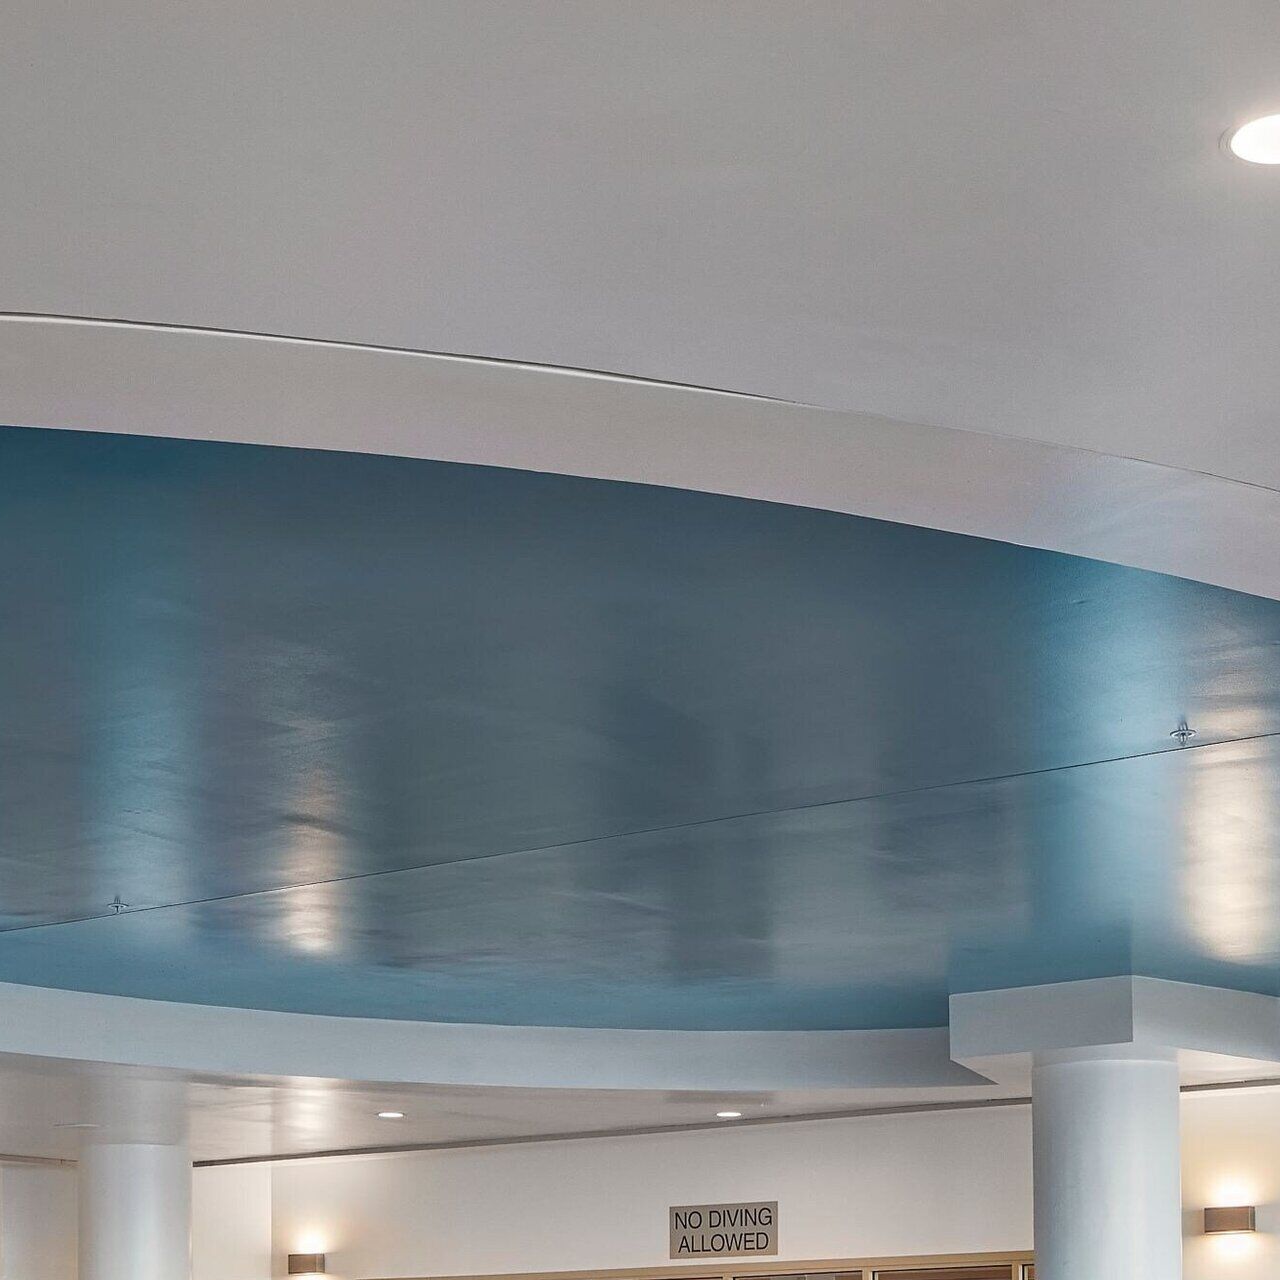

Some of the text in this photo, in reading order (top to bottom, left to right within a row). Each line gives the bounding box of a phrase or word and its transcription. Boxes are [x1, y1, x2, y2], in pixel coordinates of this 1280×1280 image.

[675, 1207, 772, 1229] NO DIVING
[678, 1232, 769, 1253] ALLOWED
